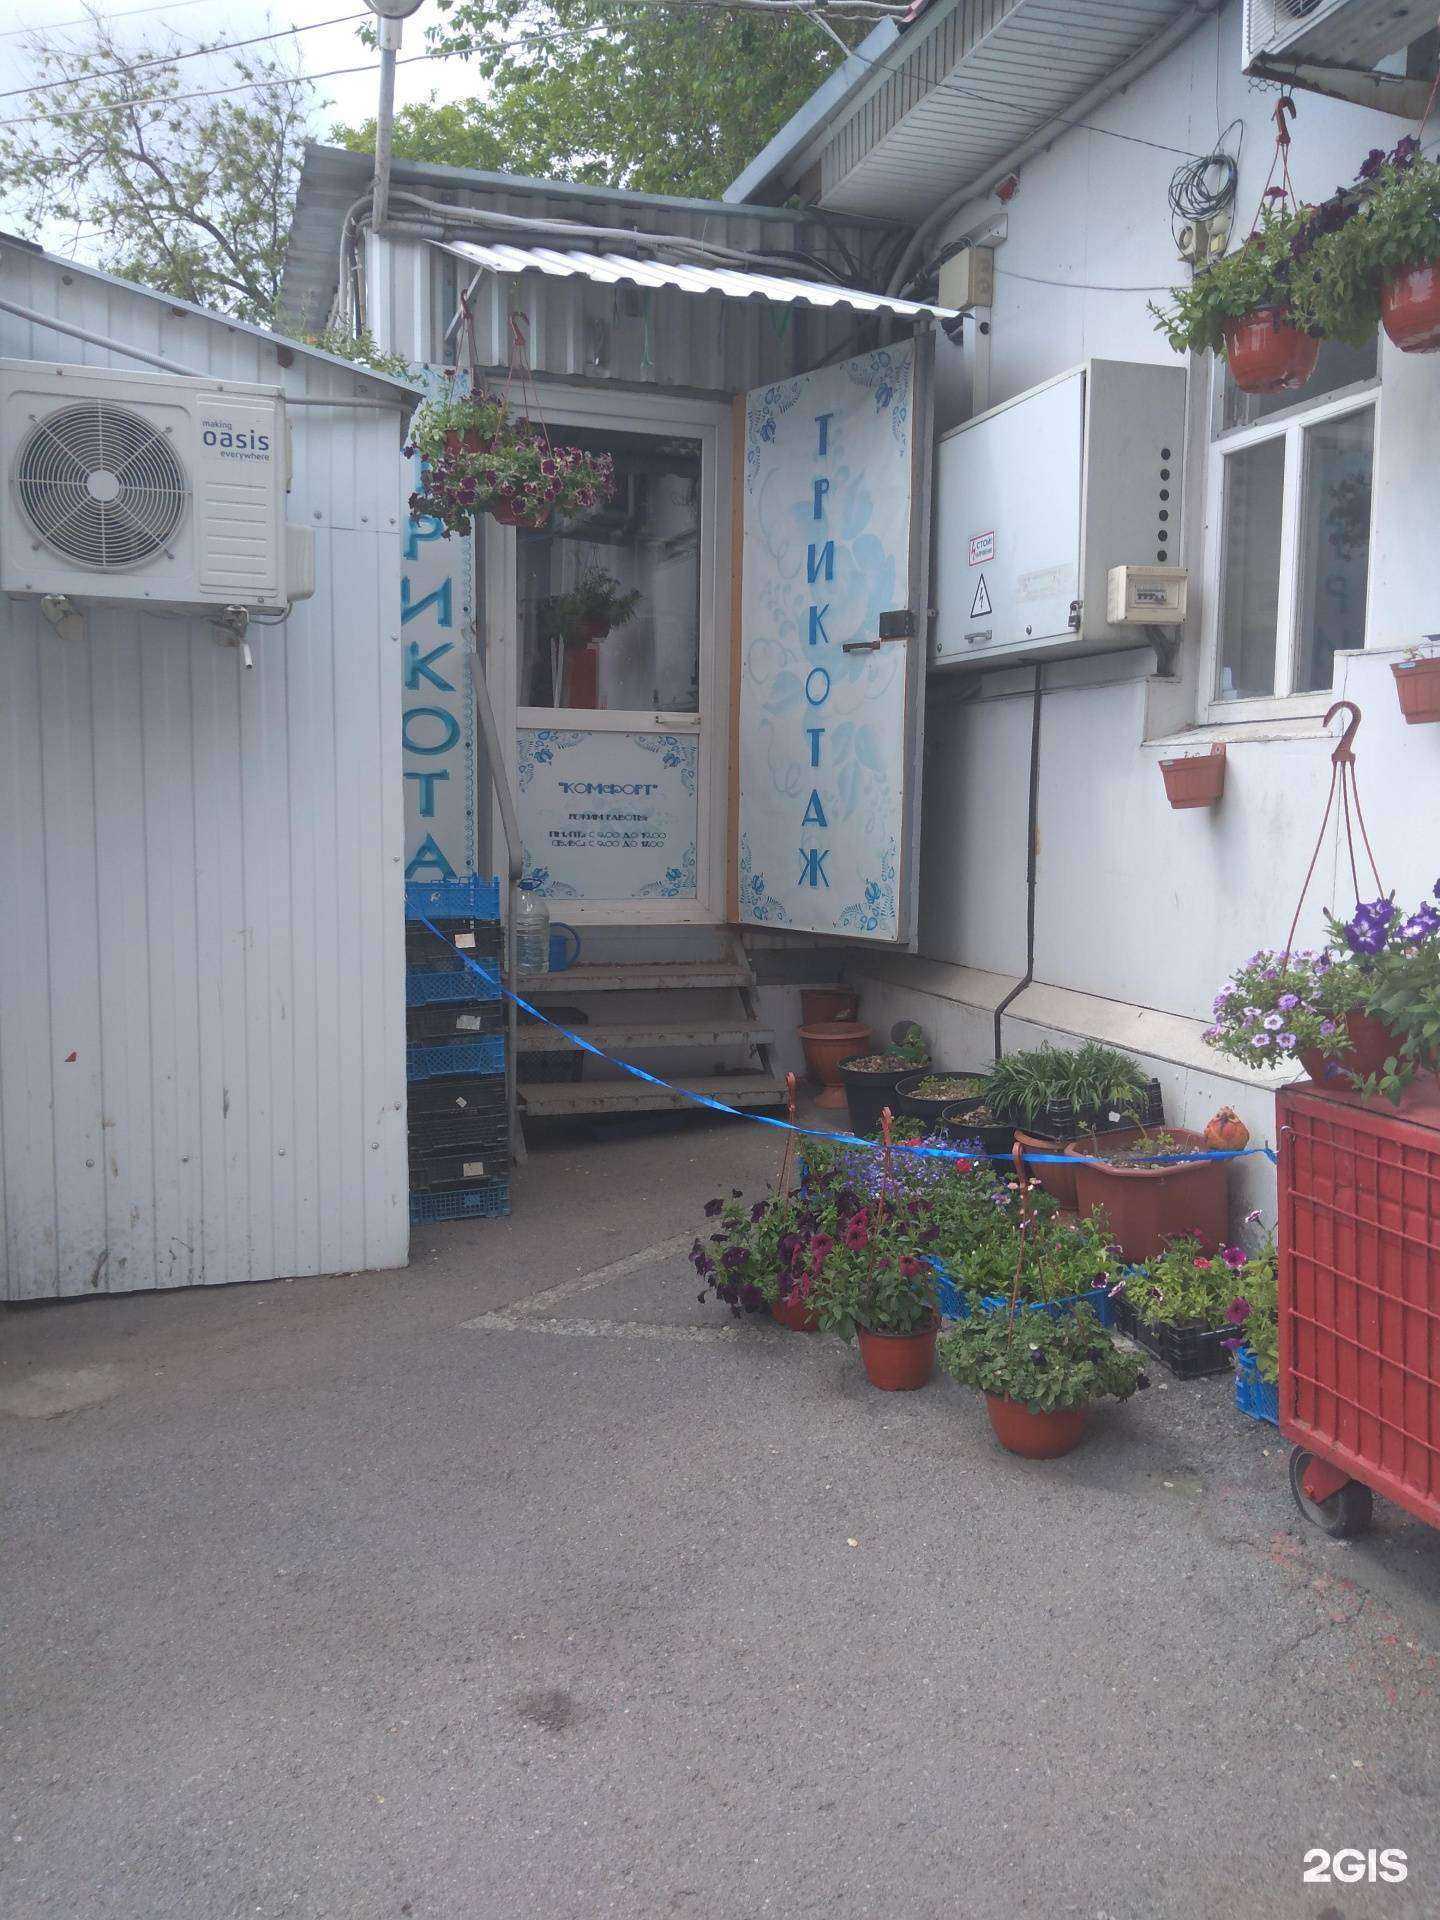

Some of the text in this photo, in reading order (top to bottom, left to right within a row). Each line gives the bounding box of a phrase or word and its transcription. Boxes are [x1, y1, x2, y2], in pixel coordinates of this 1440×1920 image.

[202, 420, 232, 430] making
[203, 429, 269, 451] oasis
[220, 451, 270, 461] everywhere
[797, 411, 834, 888] ТРИКОТАЖ
